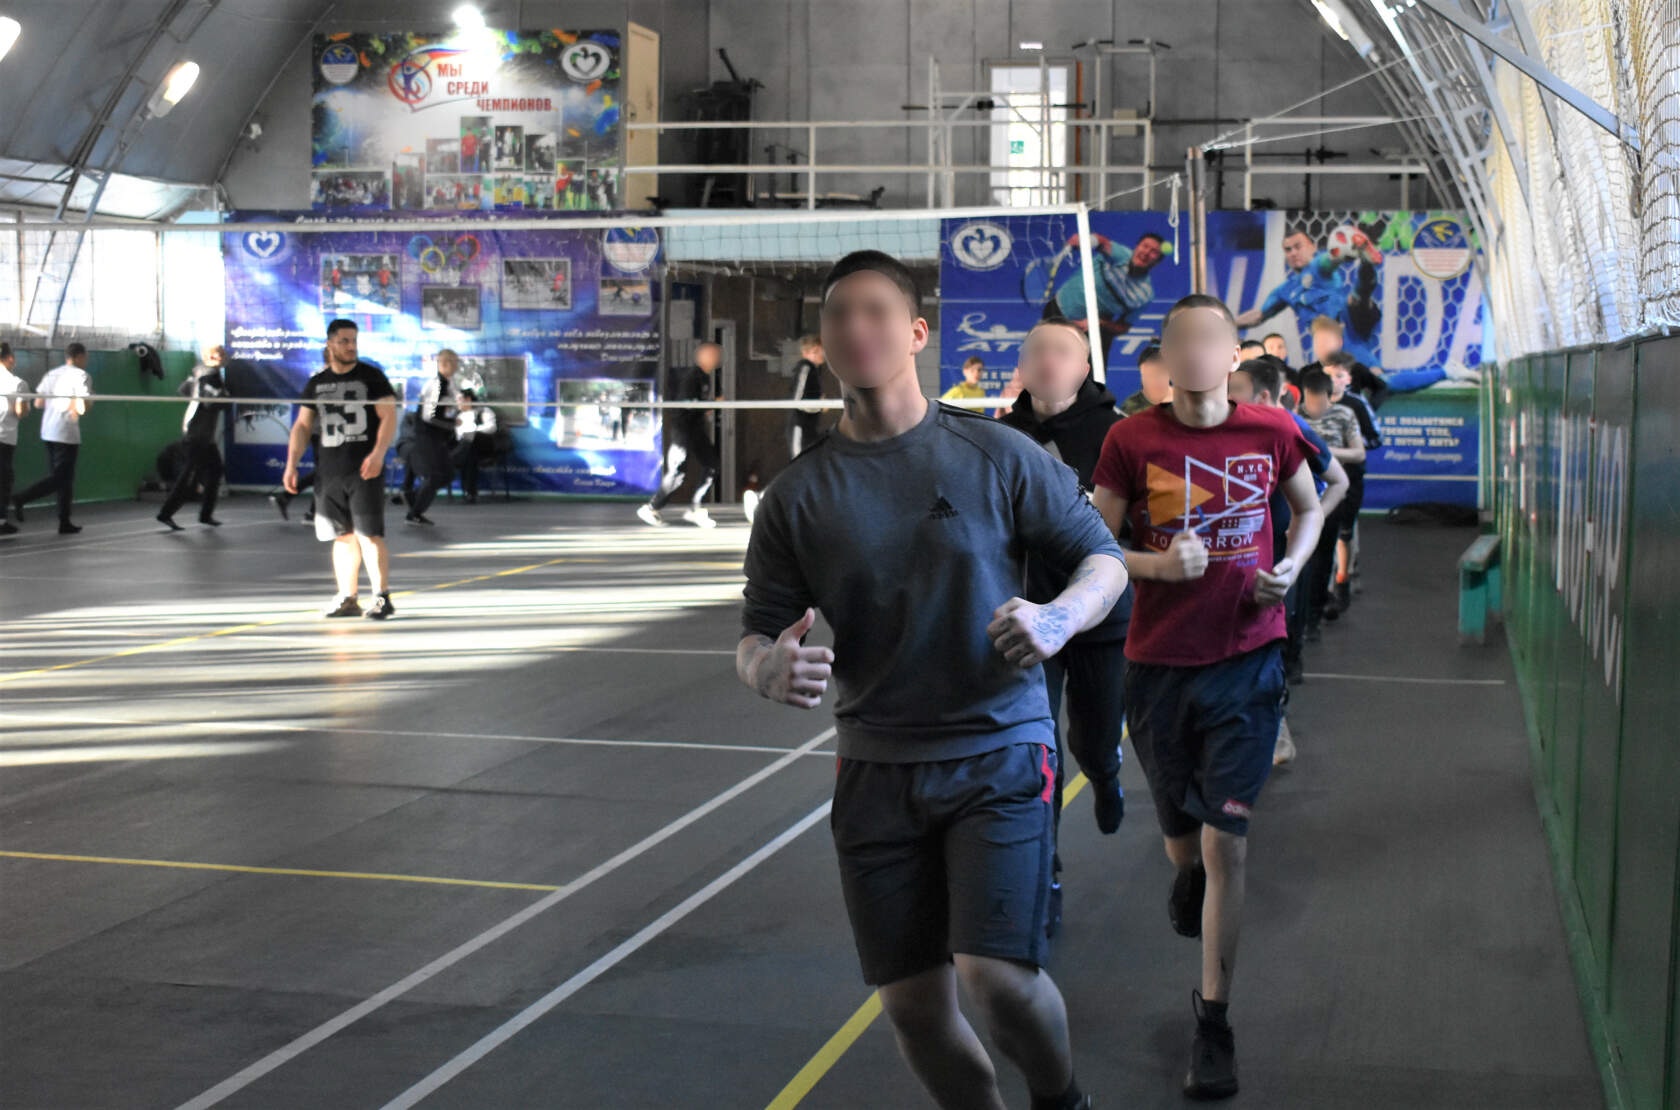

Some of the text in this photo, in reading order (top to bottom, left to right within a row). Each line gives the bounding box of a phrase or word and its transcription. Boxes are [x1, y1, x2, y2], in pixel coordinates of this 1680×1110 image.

[437, 63, 462, 77] МЫ
[447, 81, 488, 96] СРЕДИ
[476, 98, 552, 112] ЧЕМПИОНОВ
[1152, 532, 1253, 548] TORROW
